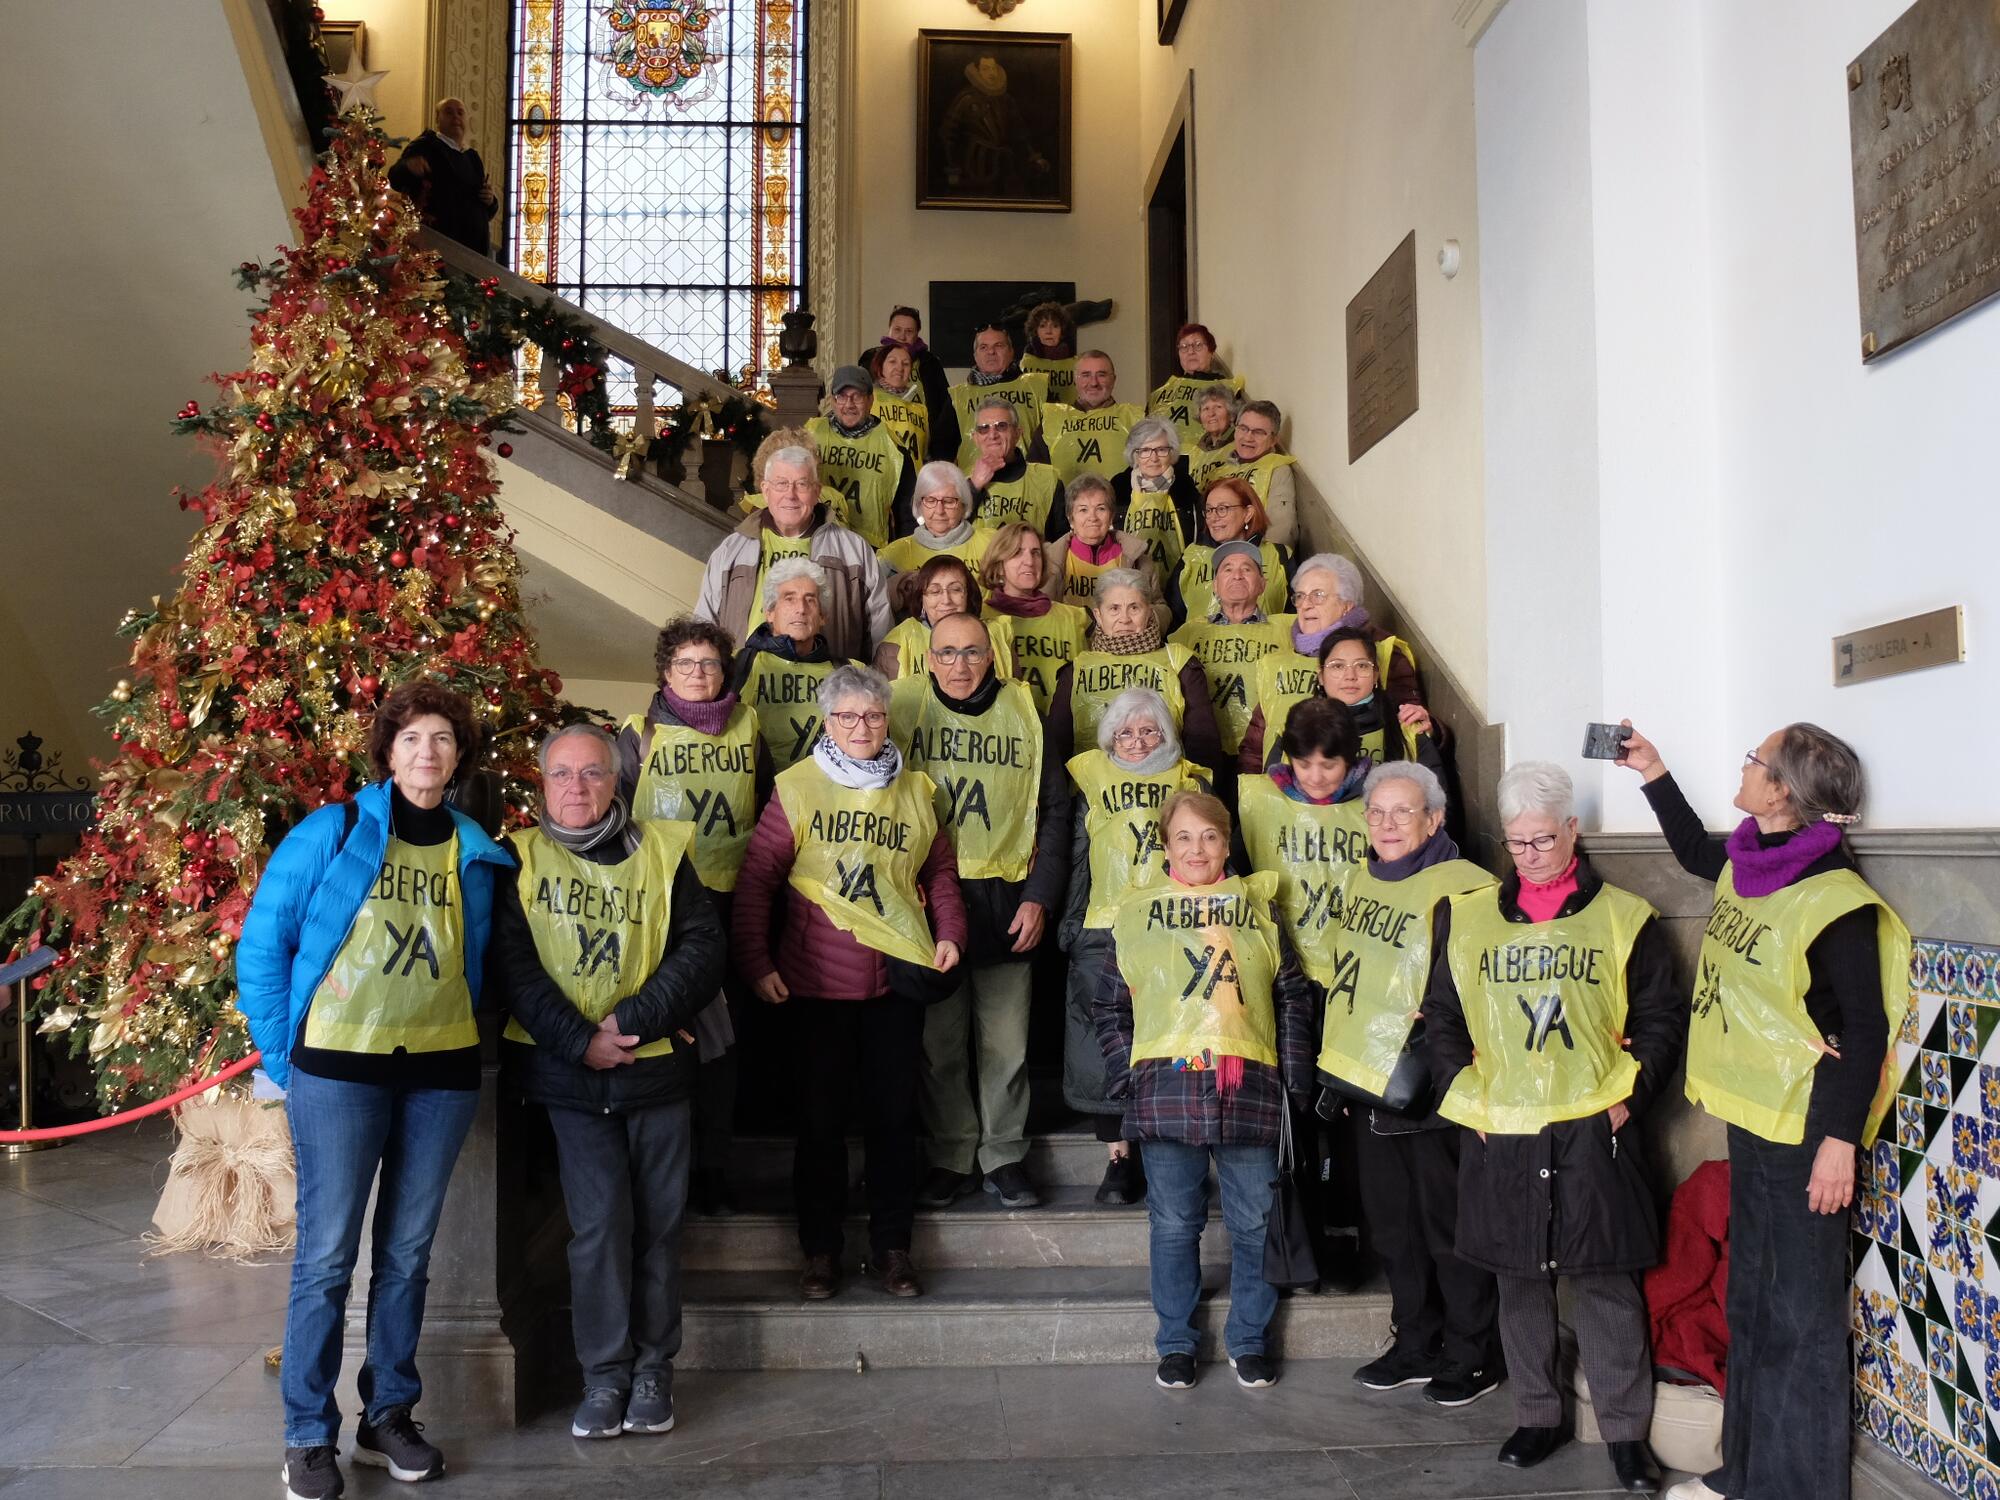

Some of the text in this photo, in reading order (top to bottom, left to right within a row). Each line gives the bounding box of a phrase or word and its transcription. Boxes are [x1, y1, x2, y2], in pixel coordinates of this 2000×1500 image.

[1061, 416, 1120, 434] ALBERGUE
[1168, 405, 1190, 426] YA
[1076, 438, 1103, 463] YA
[828, 475, 862, 514] YA
[1014, 635, 1071, 664] ERGUE
[1923, 632, 1932, 649] A
[757, 673, 824, 706] ALBER
[1212, 673, 1247, 709] YA
[648, 742, 755, 777] ALBERGUE
[909, 726, 1025, 769] ALBERGUE
[685, 788, 737, 838] YA
[943, 776, 992, 832] YA
[810, 809, 912, 853] ALBERGUE
[1277, 824, 1368, 864] ALBERG
[836, 859, 886, 917] YA
[1297, 879, 1345, 931] YA
[1340, 895, 1418, 949] BERGUE
[382, 919, 440, 981] YA
[571, 923, 622, 985] YA
[1477, 944, 1603, 985] ALBERGUE
[1180, 944, 1245, 1006] YA
[1328, 948, 1361, 1016] YA
[1515, 994, 1574, 1053] YA
